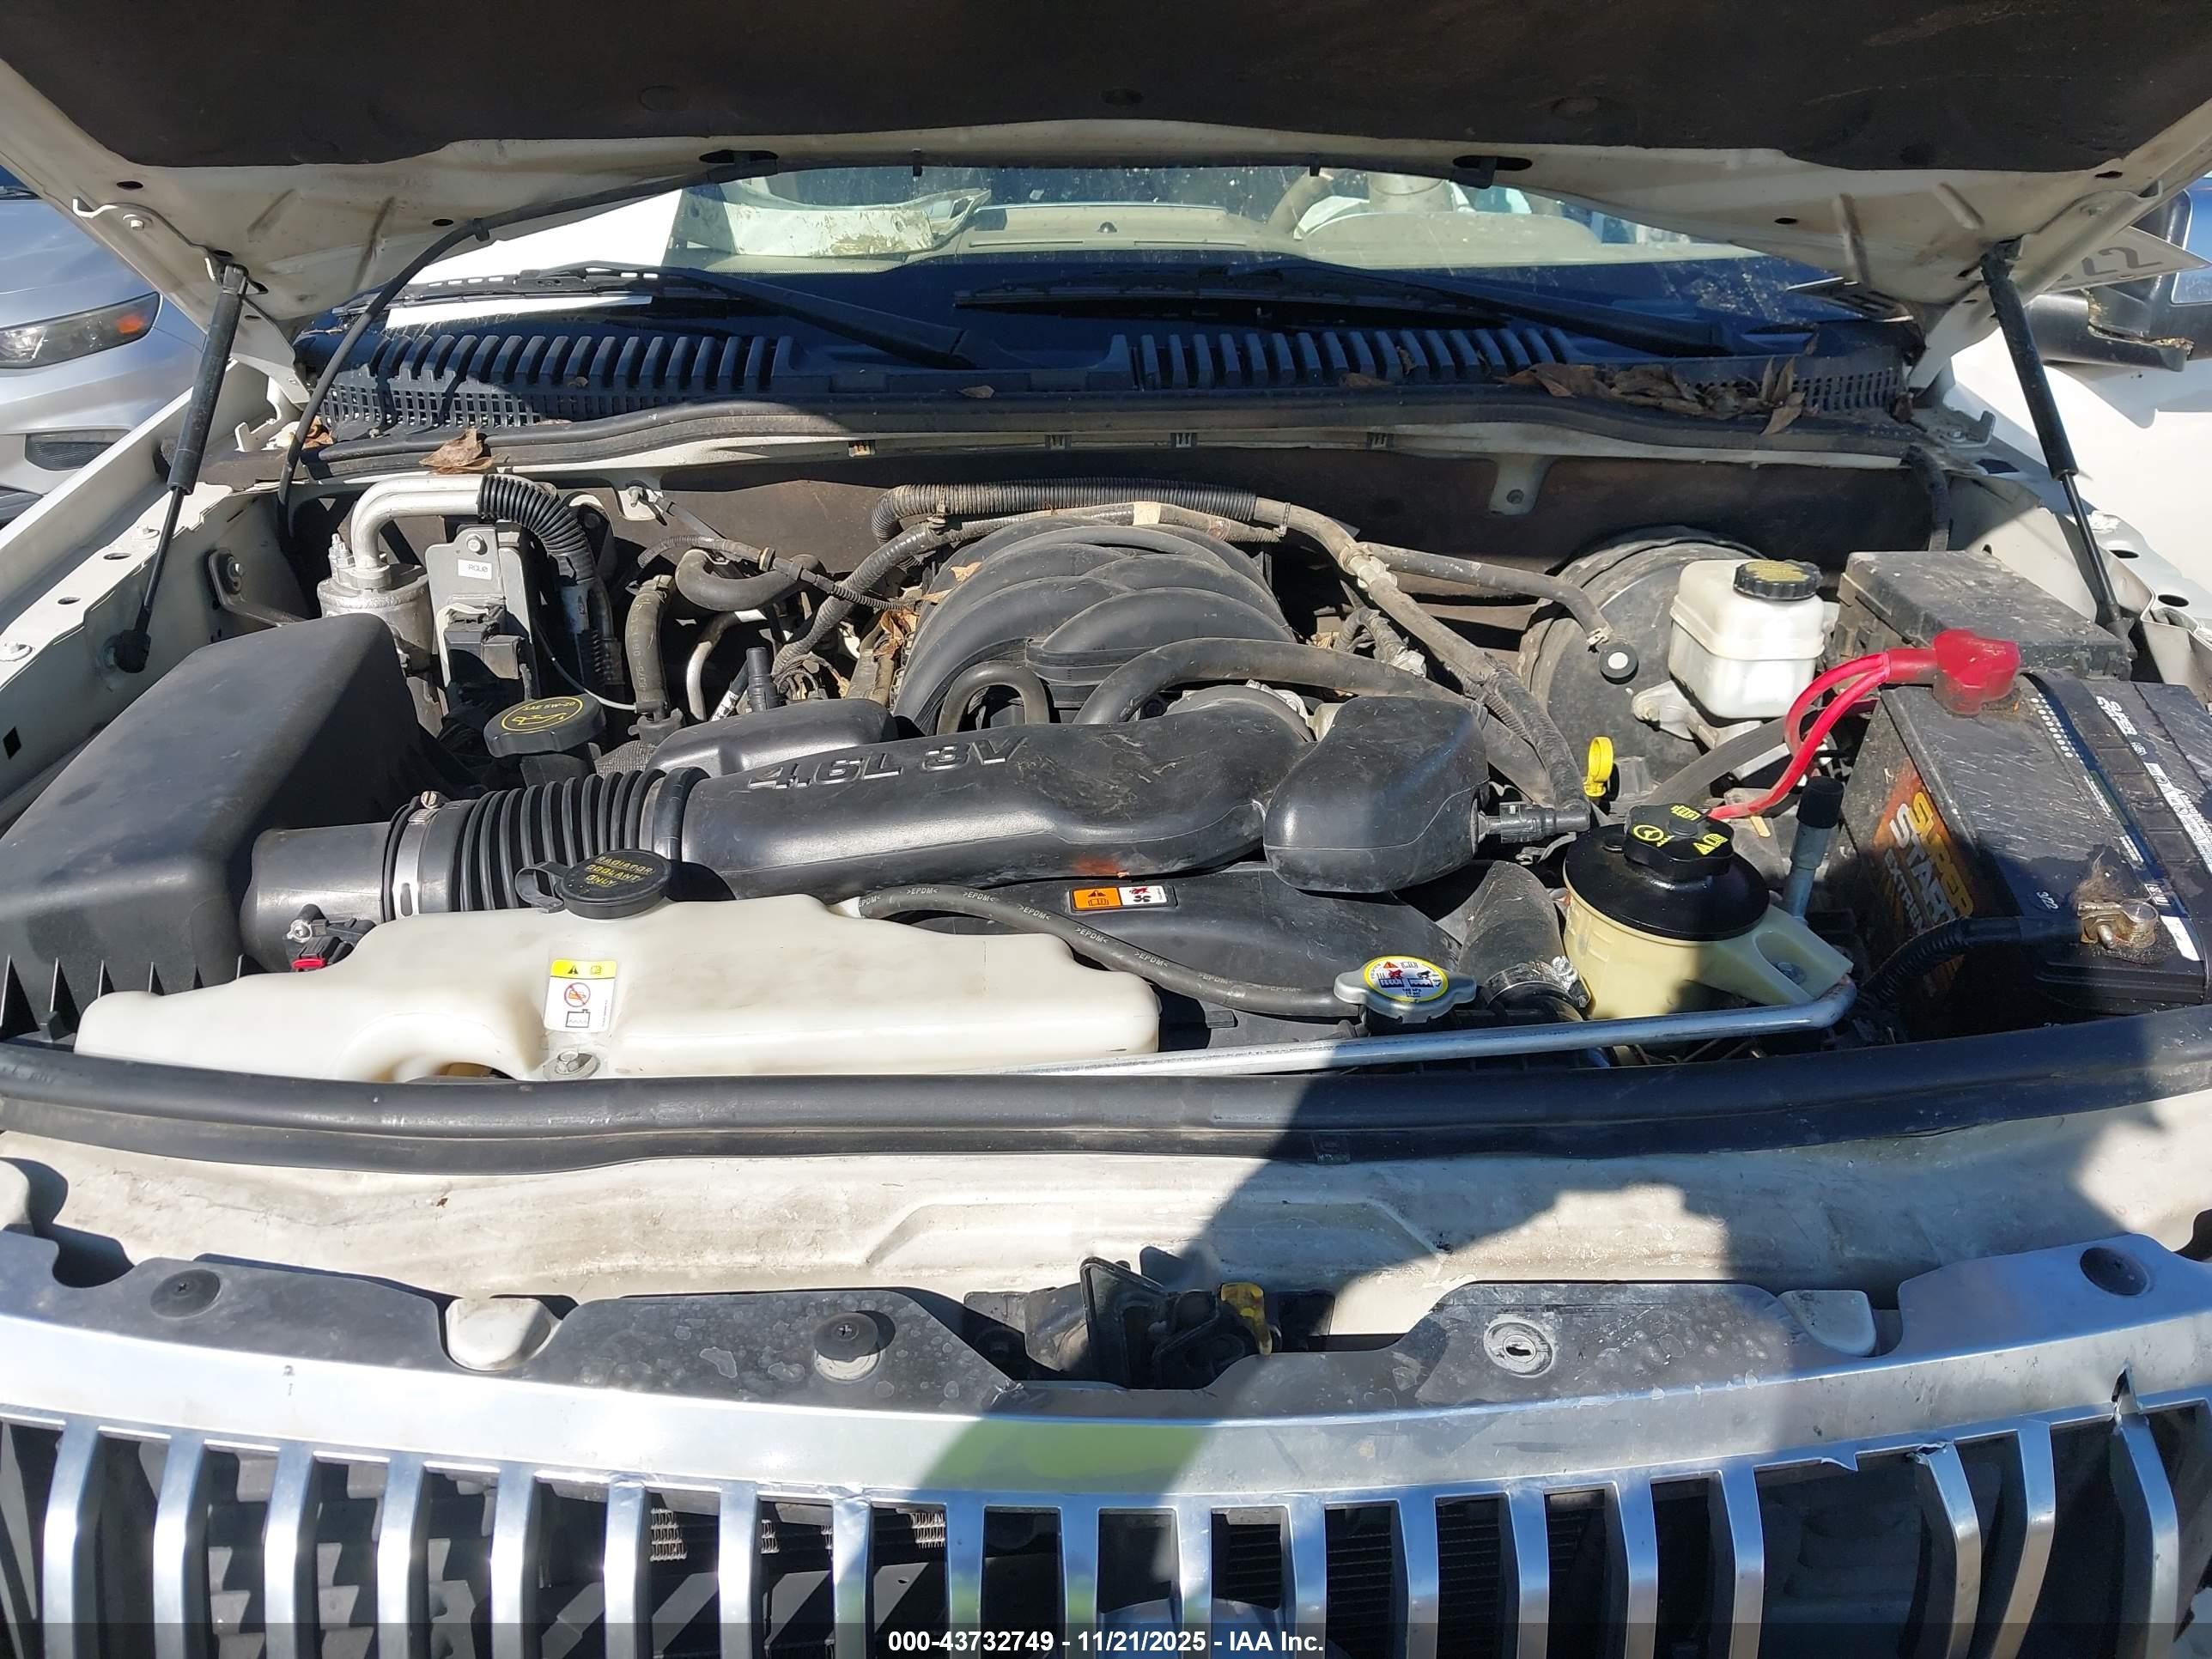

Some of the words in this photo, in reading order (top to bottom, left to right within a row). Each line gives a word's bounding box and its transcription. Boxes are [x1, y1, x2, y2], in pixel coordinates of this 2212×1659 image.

[544, 702, 576, 710] 5W-20
[2109, 700, 2138, 737] SUPER
[748, 752, 903, 790] 4.6L
[921, 736, 1028, 772] 3V
[1909, 791, 1974, 919] SUPER
[585, 864, 644, 884] COOLANT
[595, 855, 655, 876] RADIATOR
[585, 874, 618, 888] ONLY
[2036, 891, 2059, 910] 3/22
